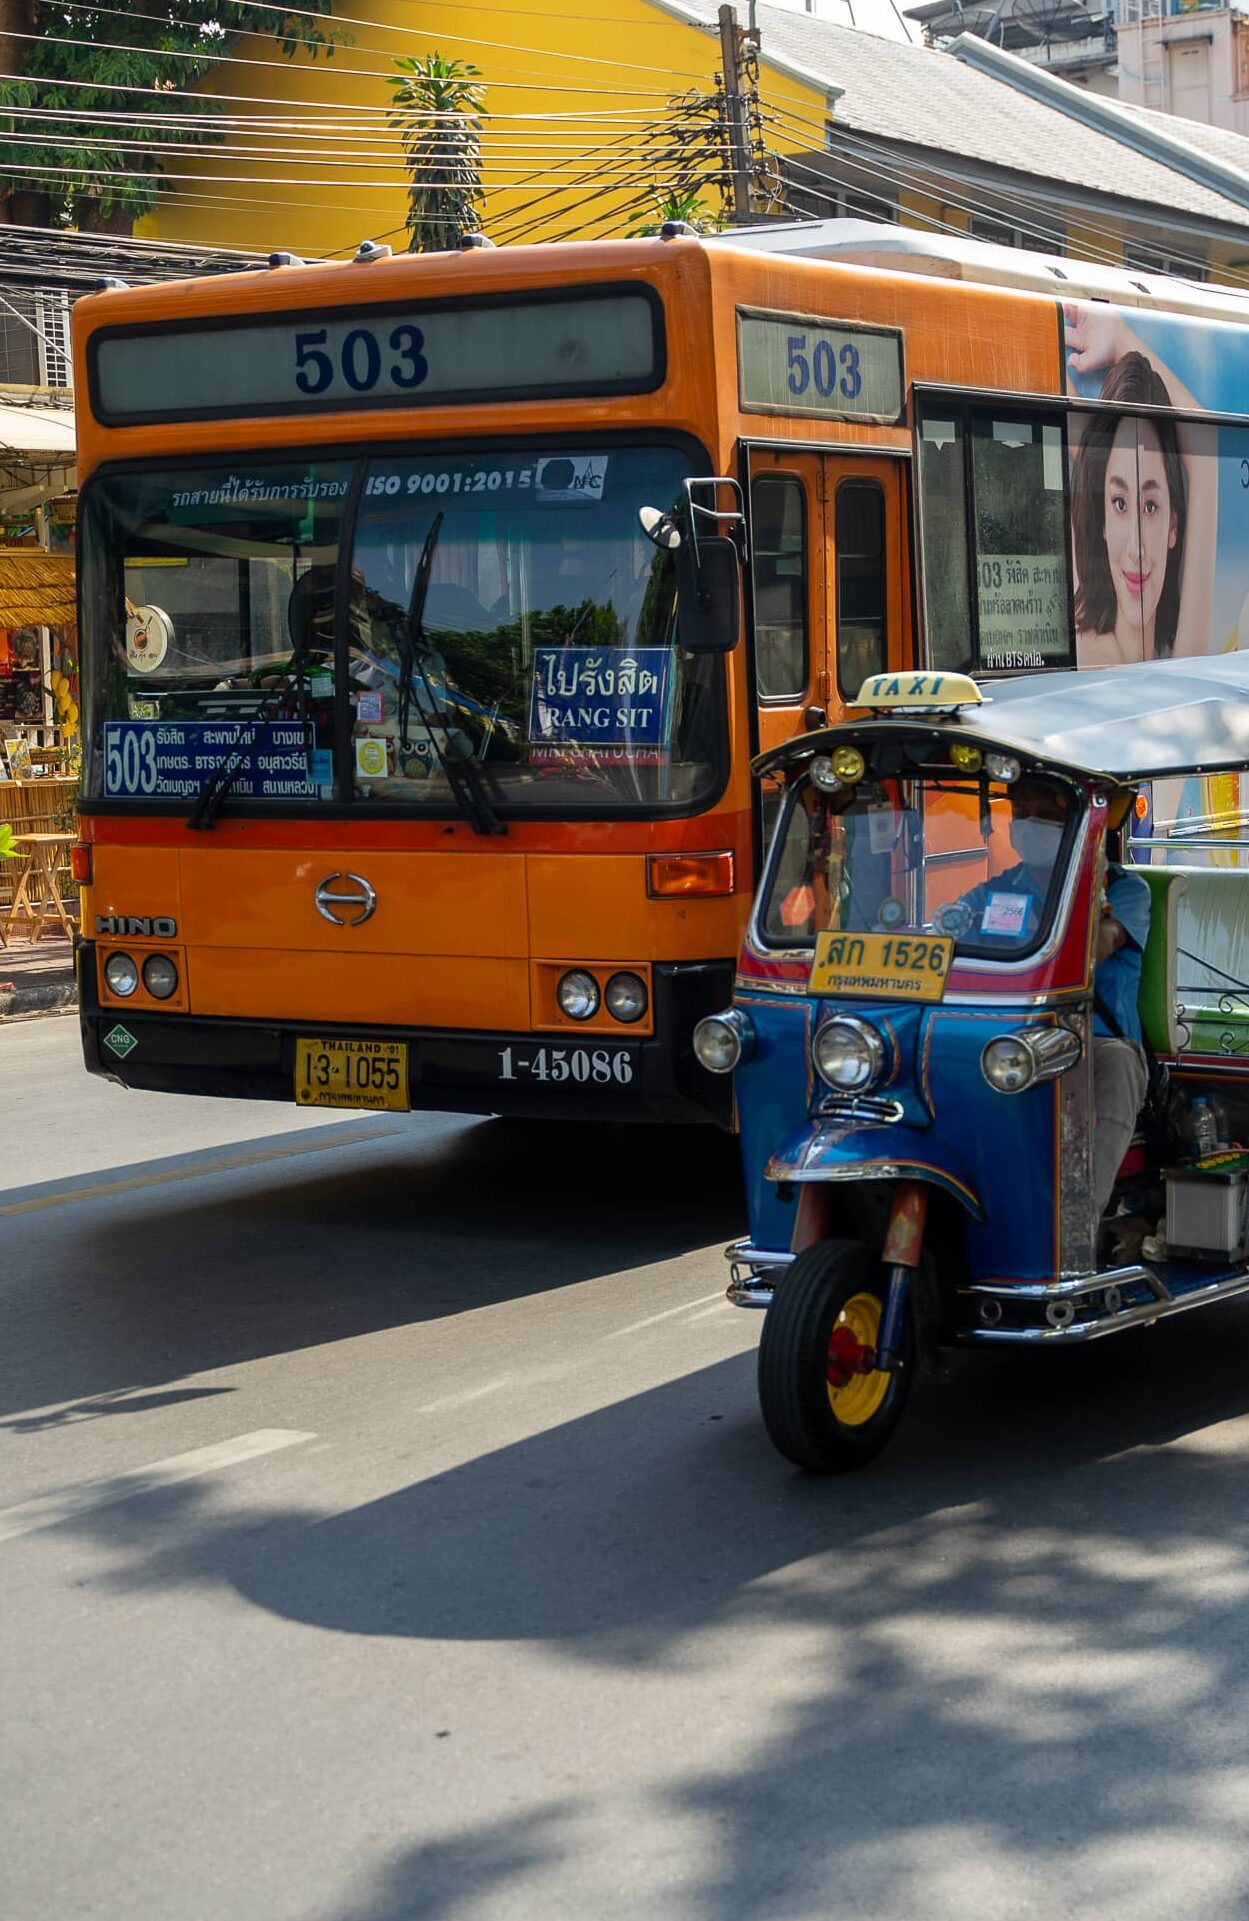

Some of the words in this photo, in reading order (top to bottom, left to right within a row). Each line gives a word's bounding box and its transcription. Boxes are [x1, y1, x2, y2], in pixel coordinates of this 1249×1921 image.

[295, 324, 429, 395] 503
[786, 334, 863, 400] 503
[171, 475, 349, 507] รถสายนี้ได้รับการรับรอง
[365, 475, 401, 495] ISO
[406, 470, 532, 494] 9001:2015
[542, 654, 658, 696] ไปรังสิต
[872, 676, 944, 696] TAXI
[548, 707, 611, 728] RANG
[616, 708, 653, 728] SIT
[156, 727, 185, 745] รังสิต
[107, 727, 157, 794] 503
[95, 915, 177, 938] HINO
[827, 936, 865, 966] สก
[882, 939, 945, 971] 1526
[827, 974, 922, 991] กรุงเทพมหานคร
[110, 1034, 130, 1044] CNG
[321, 1041, 381, 1053] THAILAND
[306, 1052, 401, 1090] 13-1055
[497, 1047, 633, 1083] 1-45086
